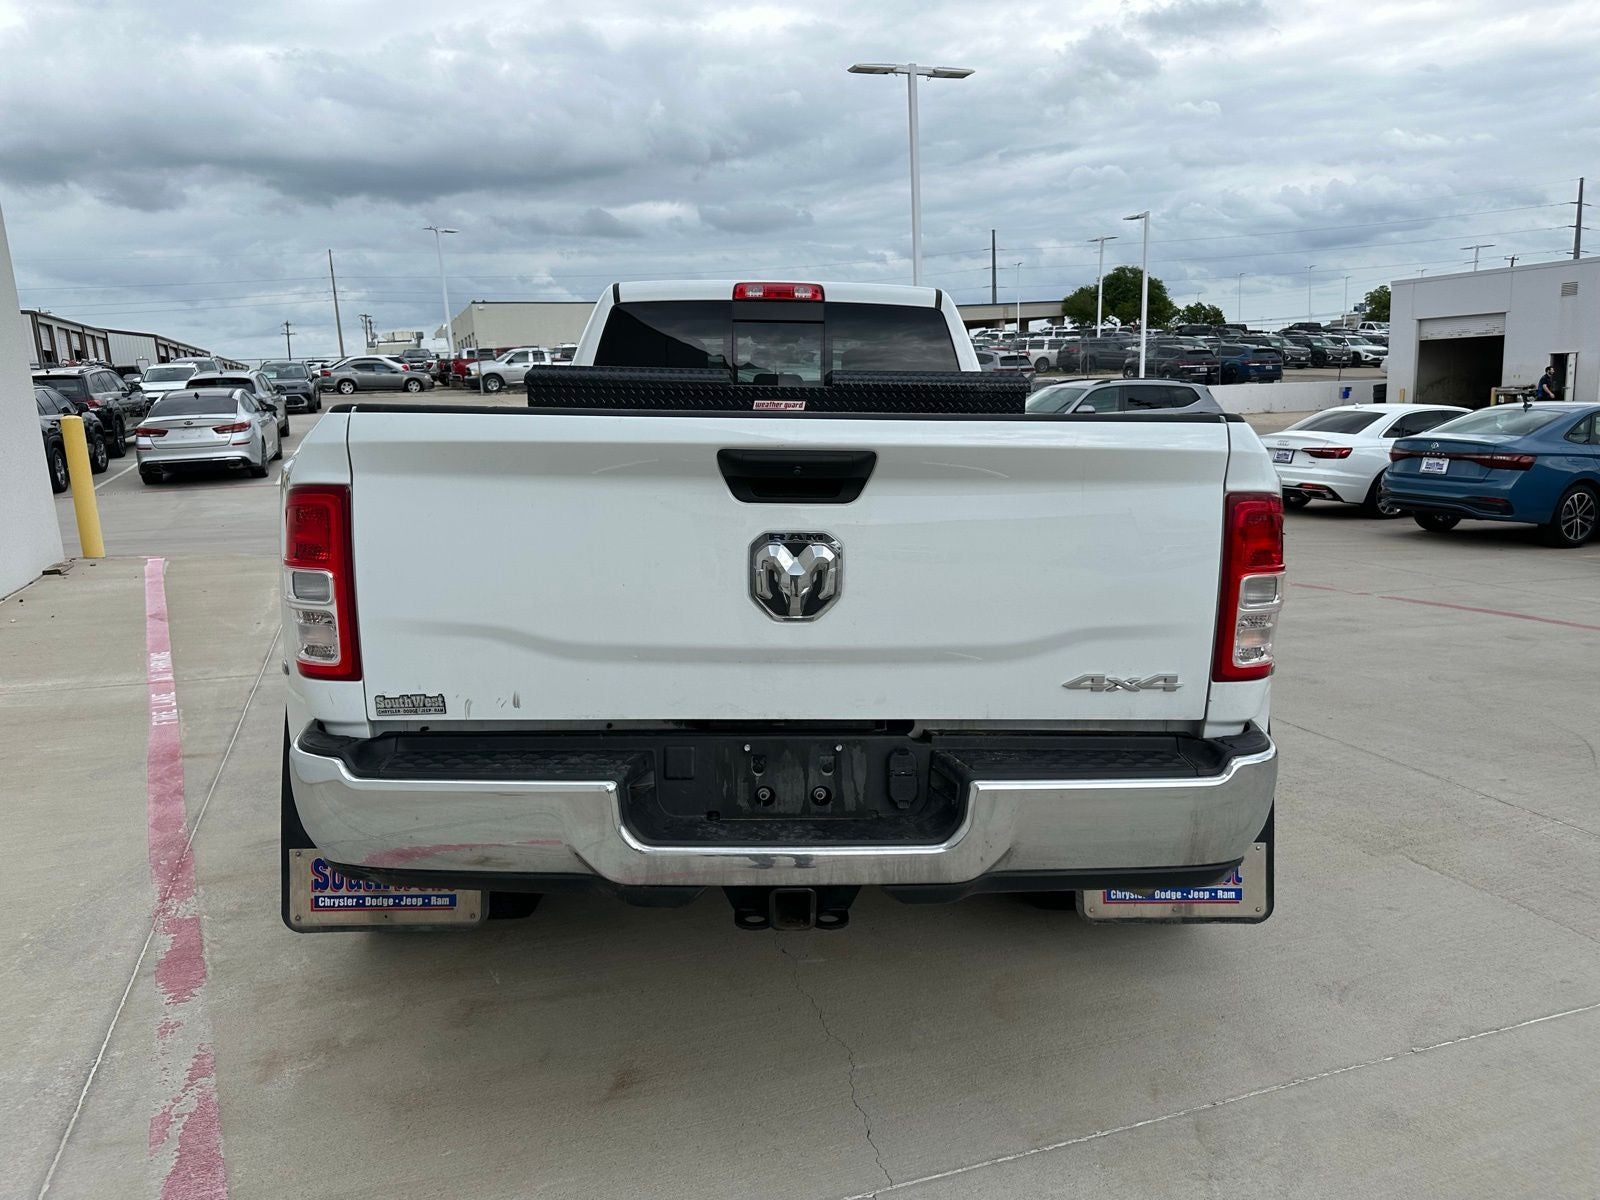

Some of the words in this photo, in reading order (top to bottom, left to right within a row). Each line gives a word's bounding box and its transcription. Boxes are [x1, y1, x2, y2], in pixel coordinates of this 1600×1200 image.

[768, 533, 824, 542] RAM
[1154, 890, 1182, 899] Dodge
[1188, 890, 1210, 899] Jeep
[1217, 890, 1236, 899] Ram
[318, 896, 357, 907] Chrysler
[365, 896, 394, 907] Dodge
[400, 896, 423, 906] Jeep
[430, 896, 450, 905] Ram
